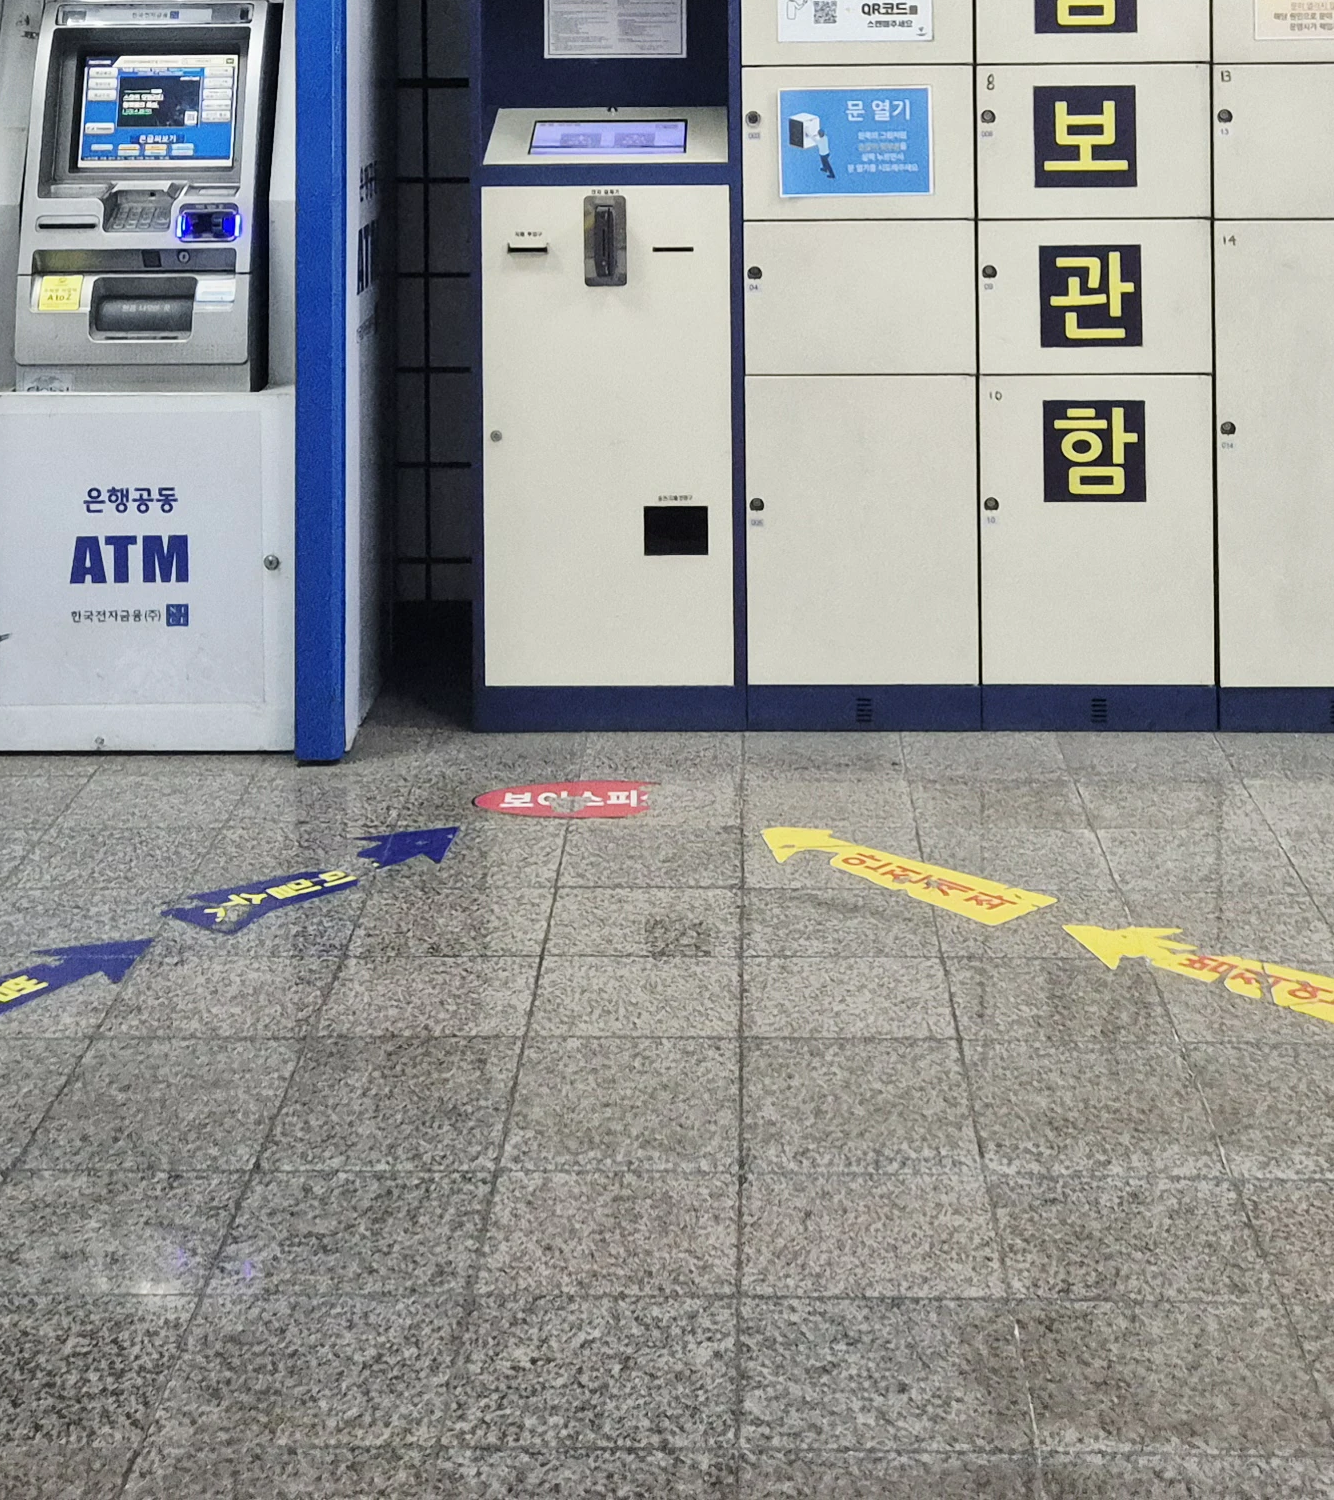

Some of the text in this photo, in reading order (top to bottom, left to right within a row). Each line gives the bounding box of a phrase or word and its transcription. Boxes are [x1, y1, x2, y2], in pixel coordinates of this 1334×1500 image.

[986, 74, 996, 91] 8
[1221, 71, 1232, 82] 13
[845, 99, 911, 121] 문 열기
[83, 486, 178, 514] 은행공동
[69, 534, 190, 585] ATM
[71, 608, 161, 624] 한국전자금융(주)
